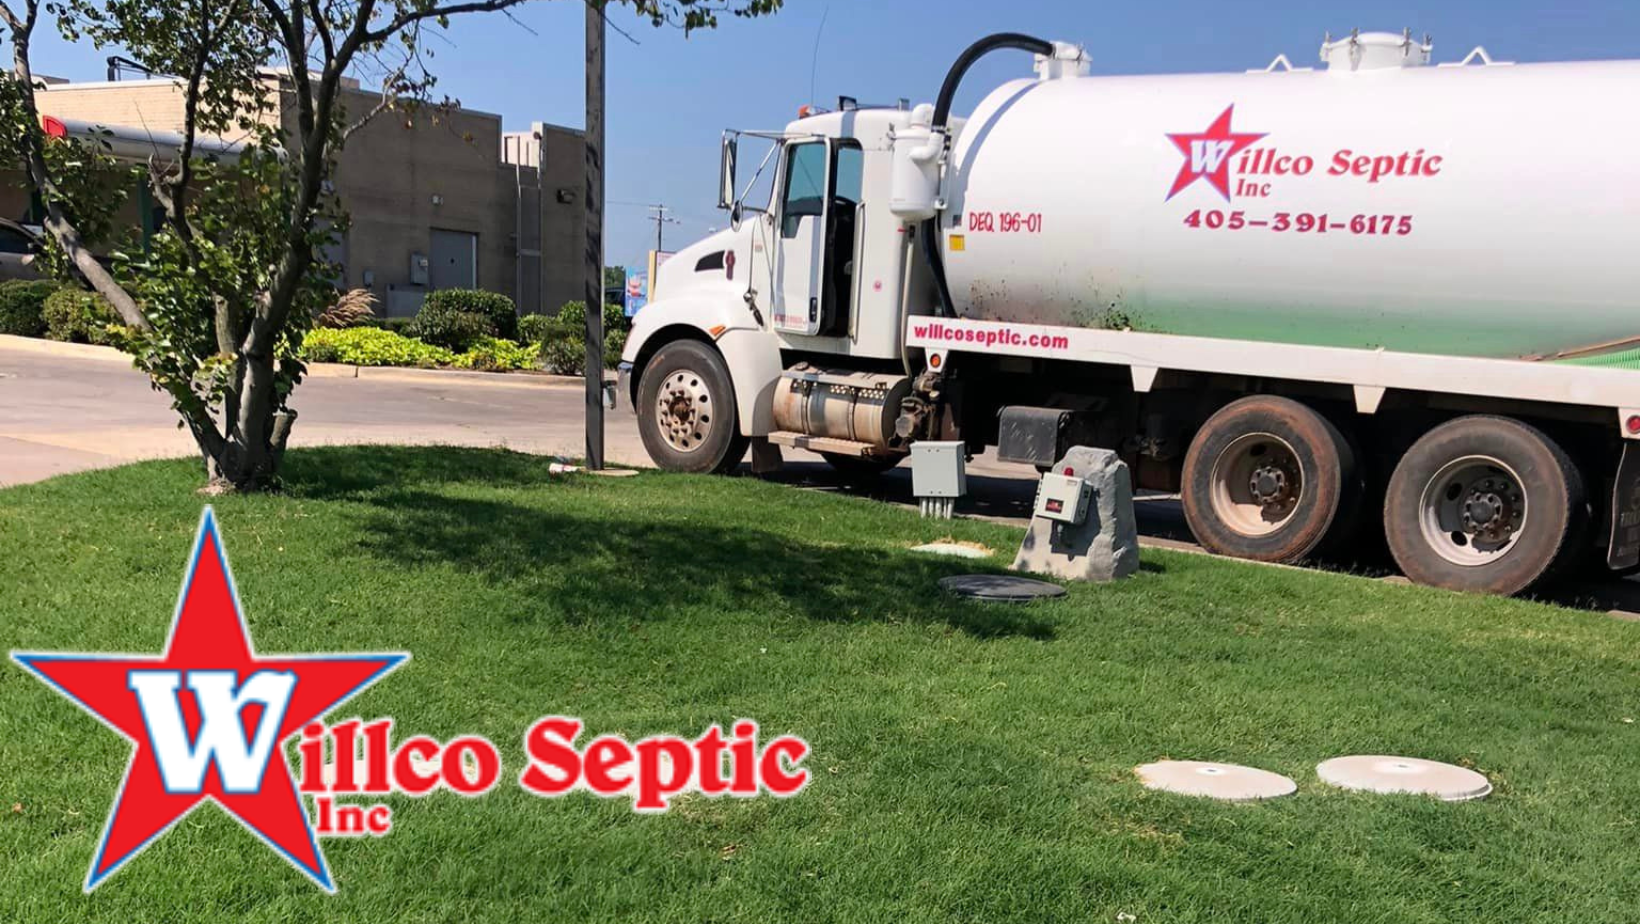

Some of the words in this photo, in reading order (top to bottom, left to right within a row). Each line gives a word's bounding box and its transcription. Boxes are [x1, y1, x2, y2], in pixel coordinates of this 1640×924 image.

[1327, 149, 1443, 183] Septic
[1236, 178, 1271, 197] Inc
[969, 211, 994, 232] DEQ
[1000, 213, 1042, 233] 196-01
[1183, 209, 1413, 236] 405-391-6175
[914, 323, 1069, 349] willcoseptic.com
